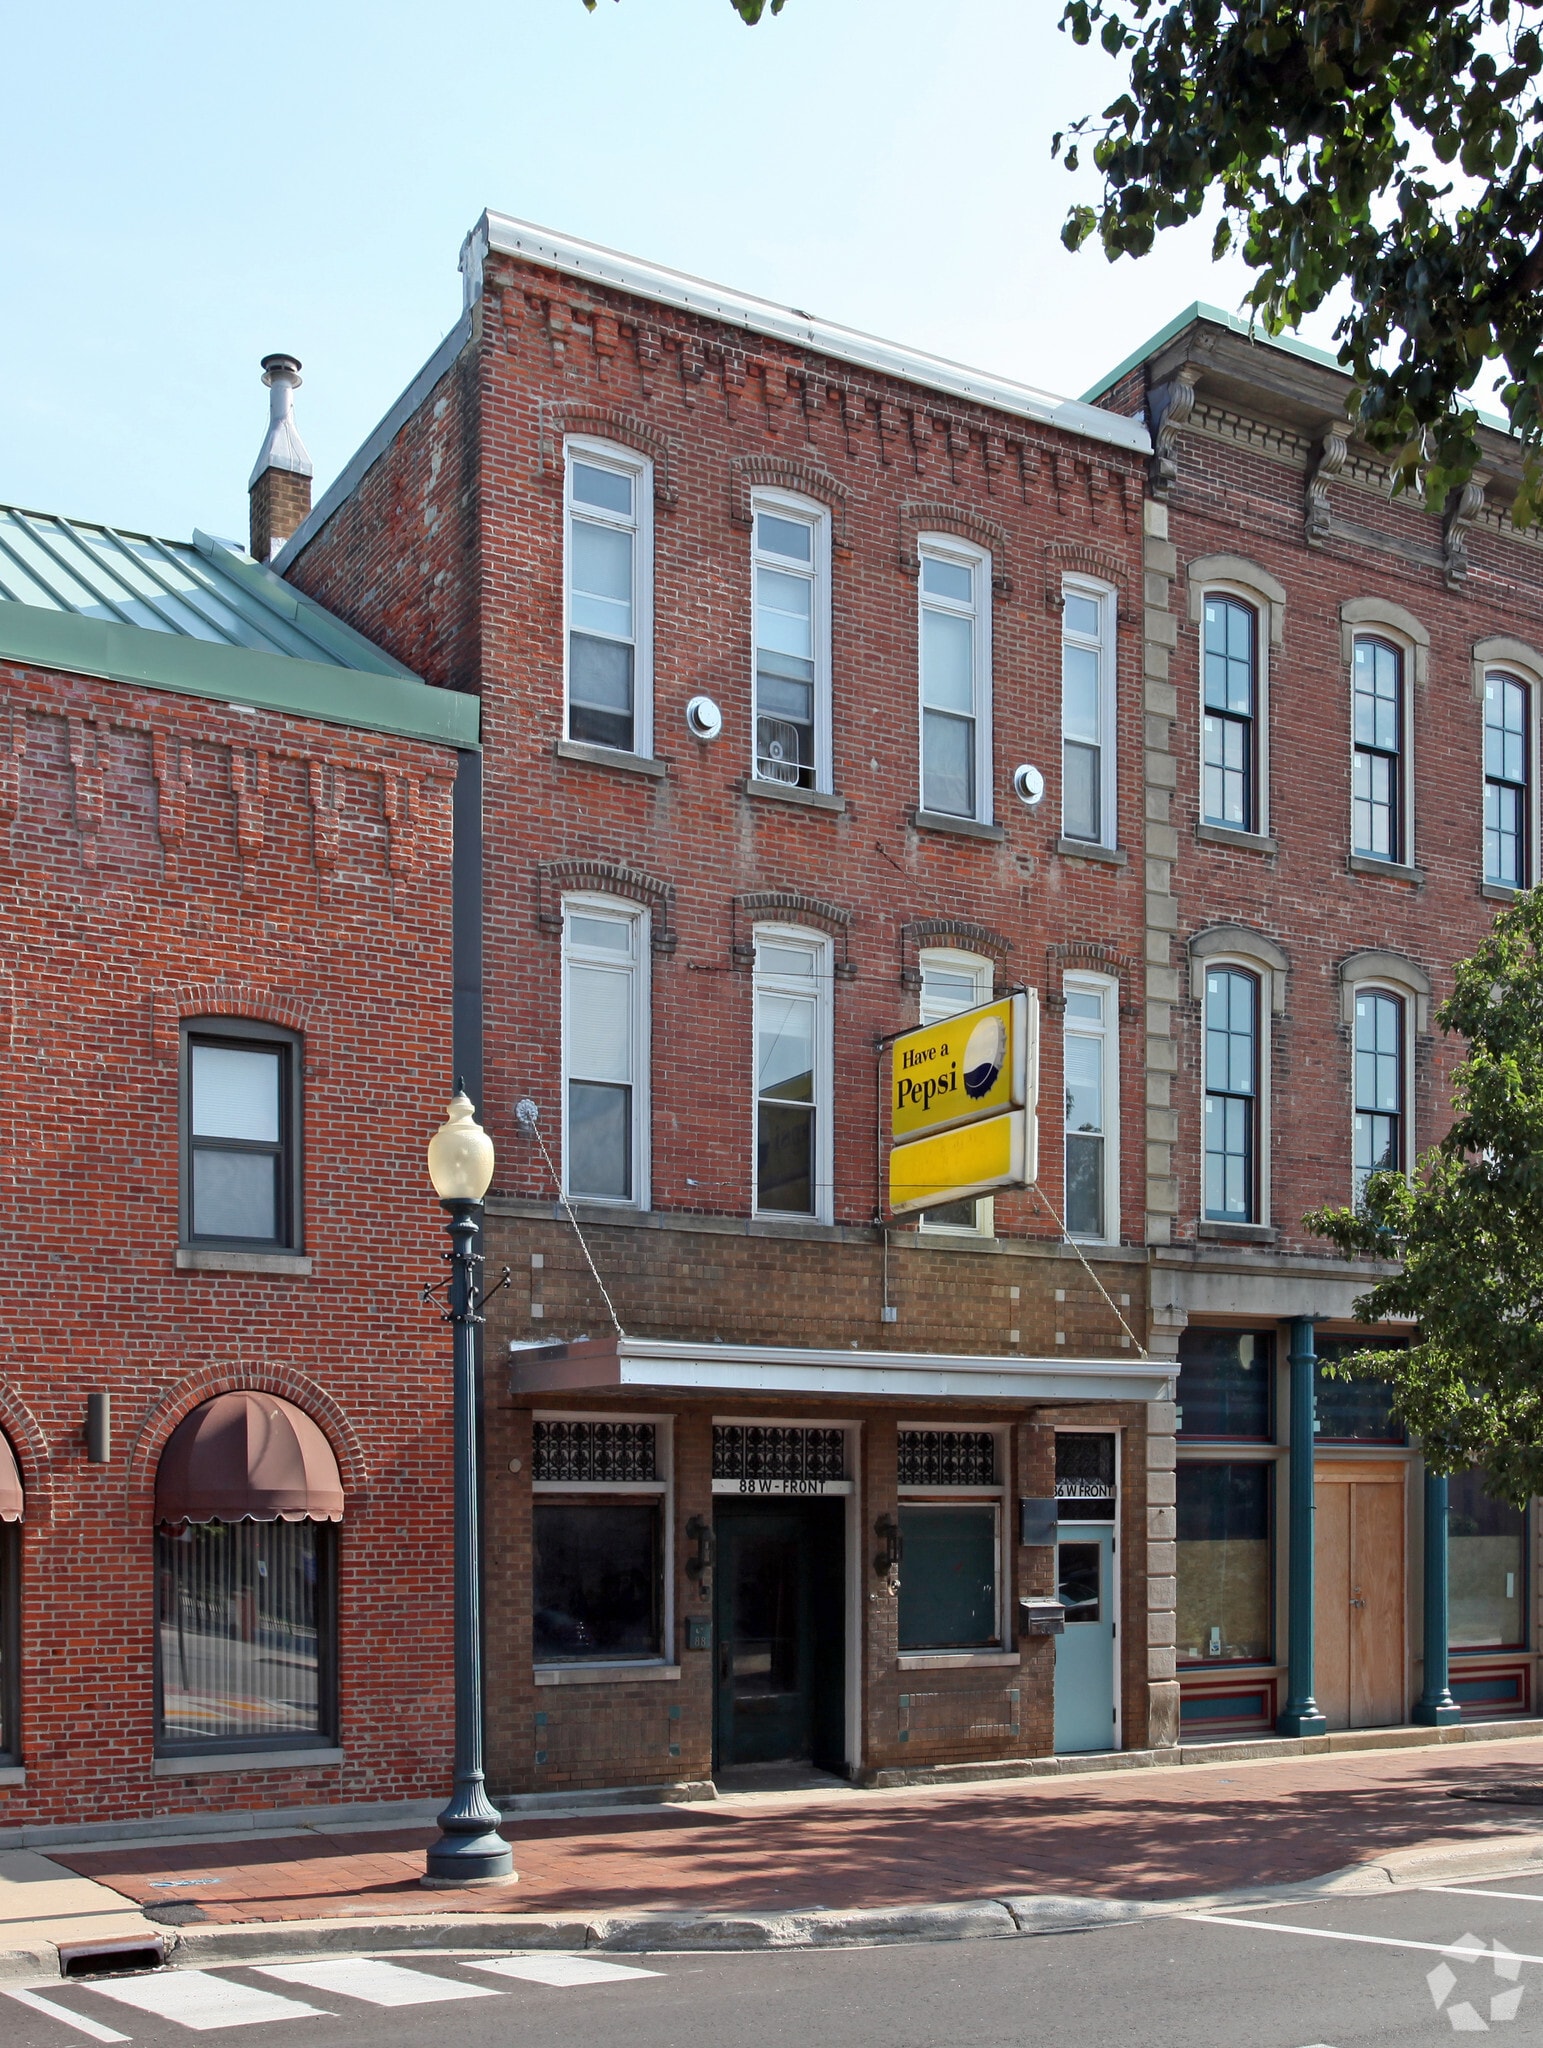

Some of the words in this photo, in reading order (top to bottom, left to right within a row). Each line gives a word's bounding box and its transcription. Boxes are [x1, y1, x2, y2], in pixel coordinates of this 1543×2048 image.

[903, 1049, 936, 1069] Have
[940, 1043, 949, 1057] a
[897, 1061, 957, 1111] Pepsi
[739, 1480, 756, 1493] 88
[1066, 1485, 1077, 1497] W
[1080, 1485, 1112, 1497] FRONT
